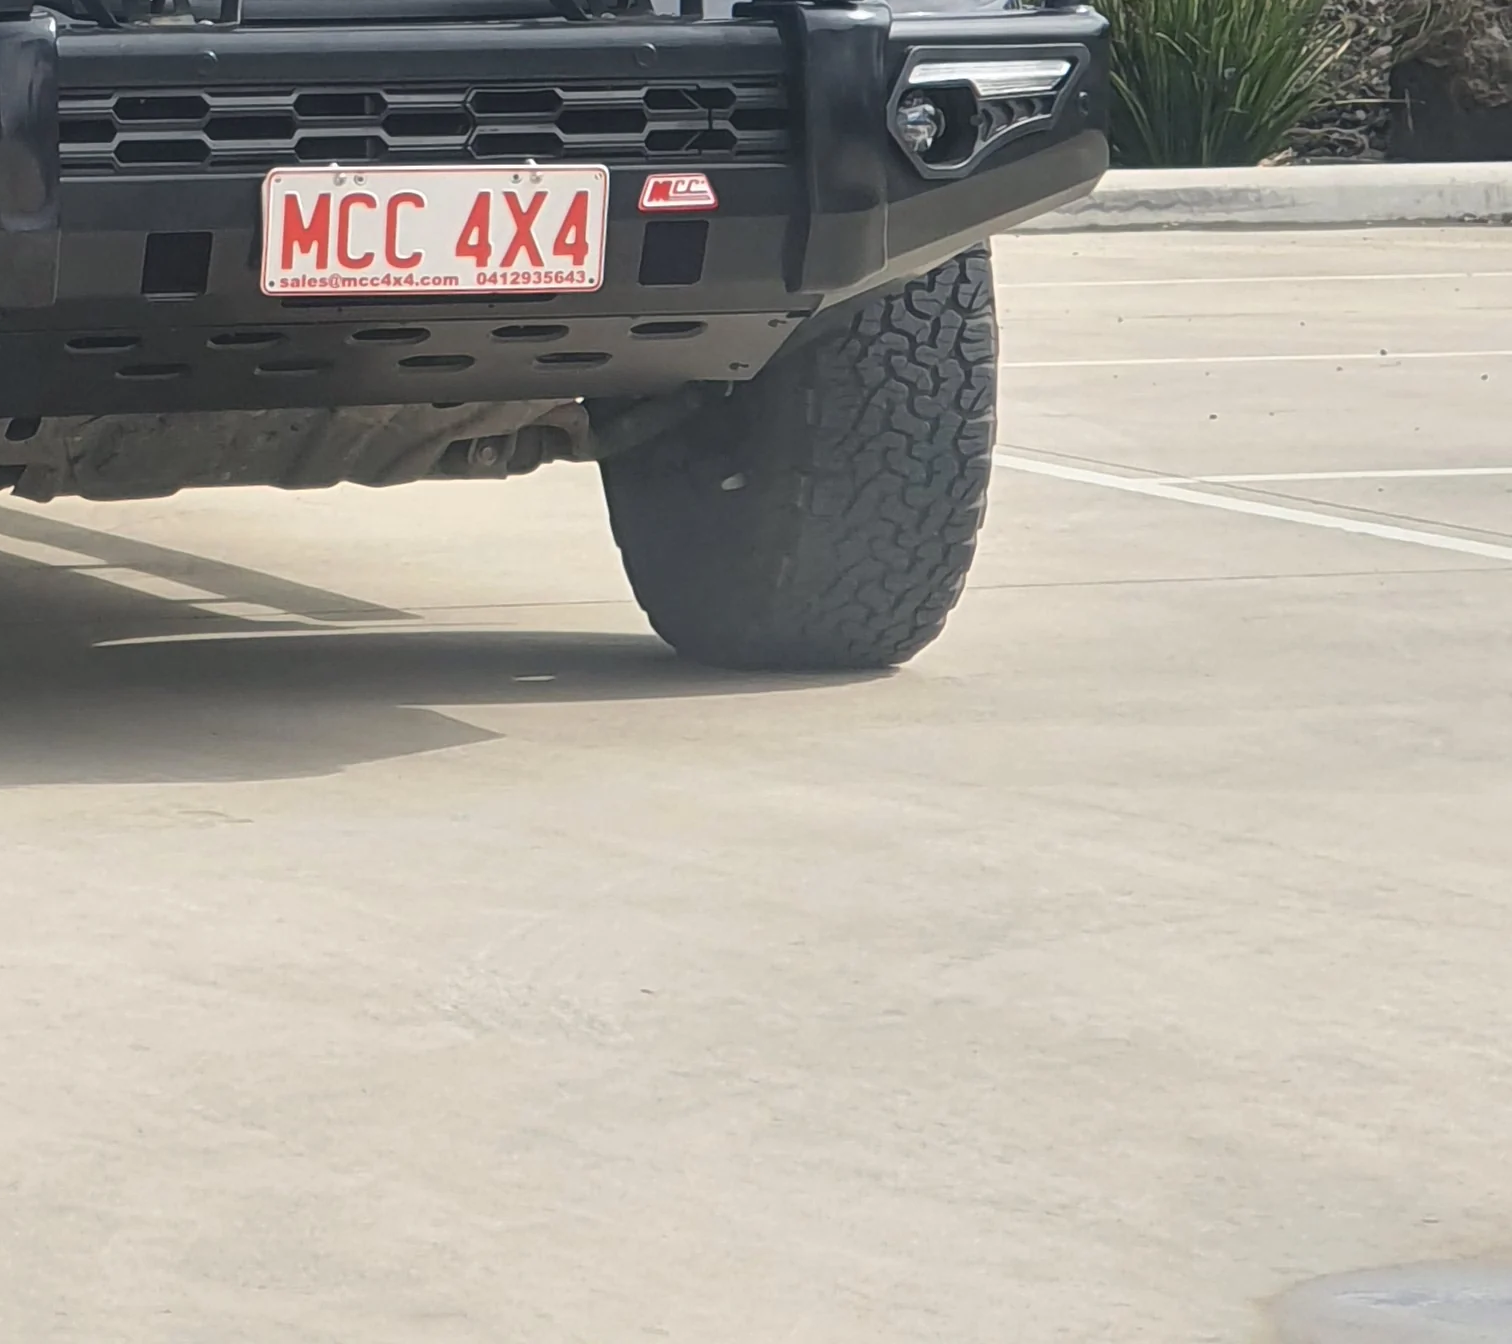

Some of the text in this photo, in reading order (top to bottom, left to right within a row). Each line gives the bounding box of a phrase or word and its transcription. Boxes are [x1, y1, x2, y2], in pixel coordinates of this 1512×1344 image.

[647, 179, 709, 202] MCC
[280, 190, 589, 271] MCC 4X4
[279, 270, 587, 289] sales@mcc4x4.com 0412935643
